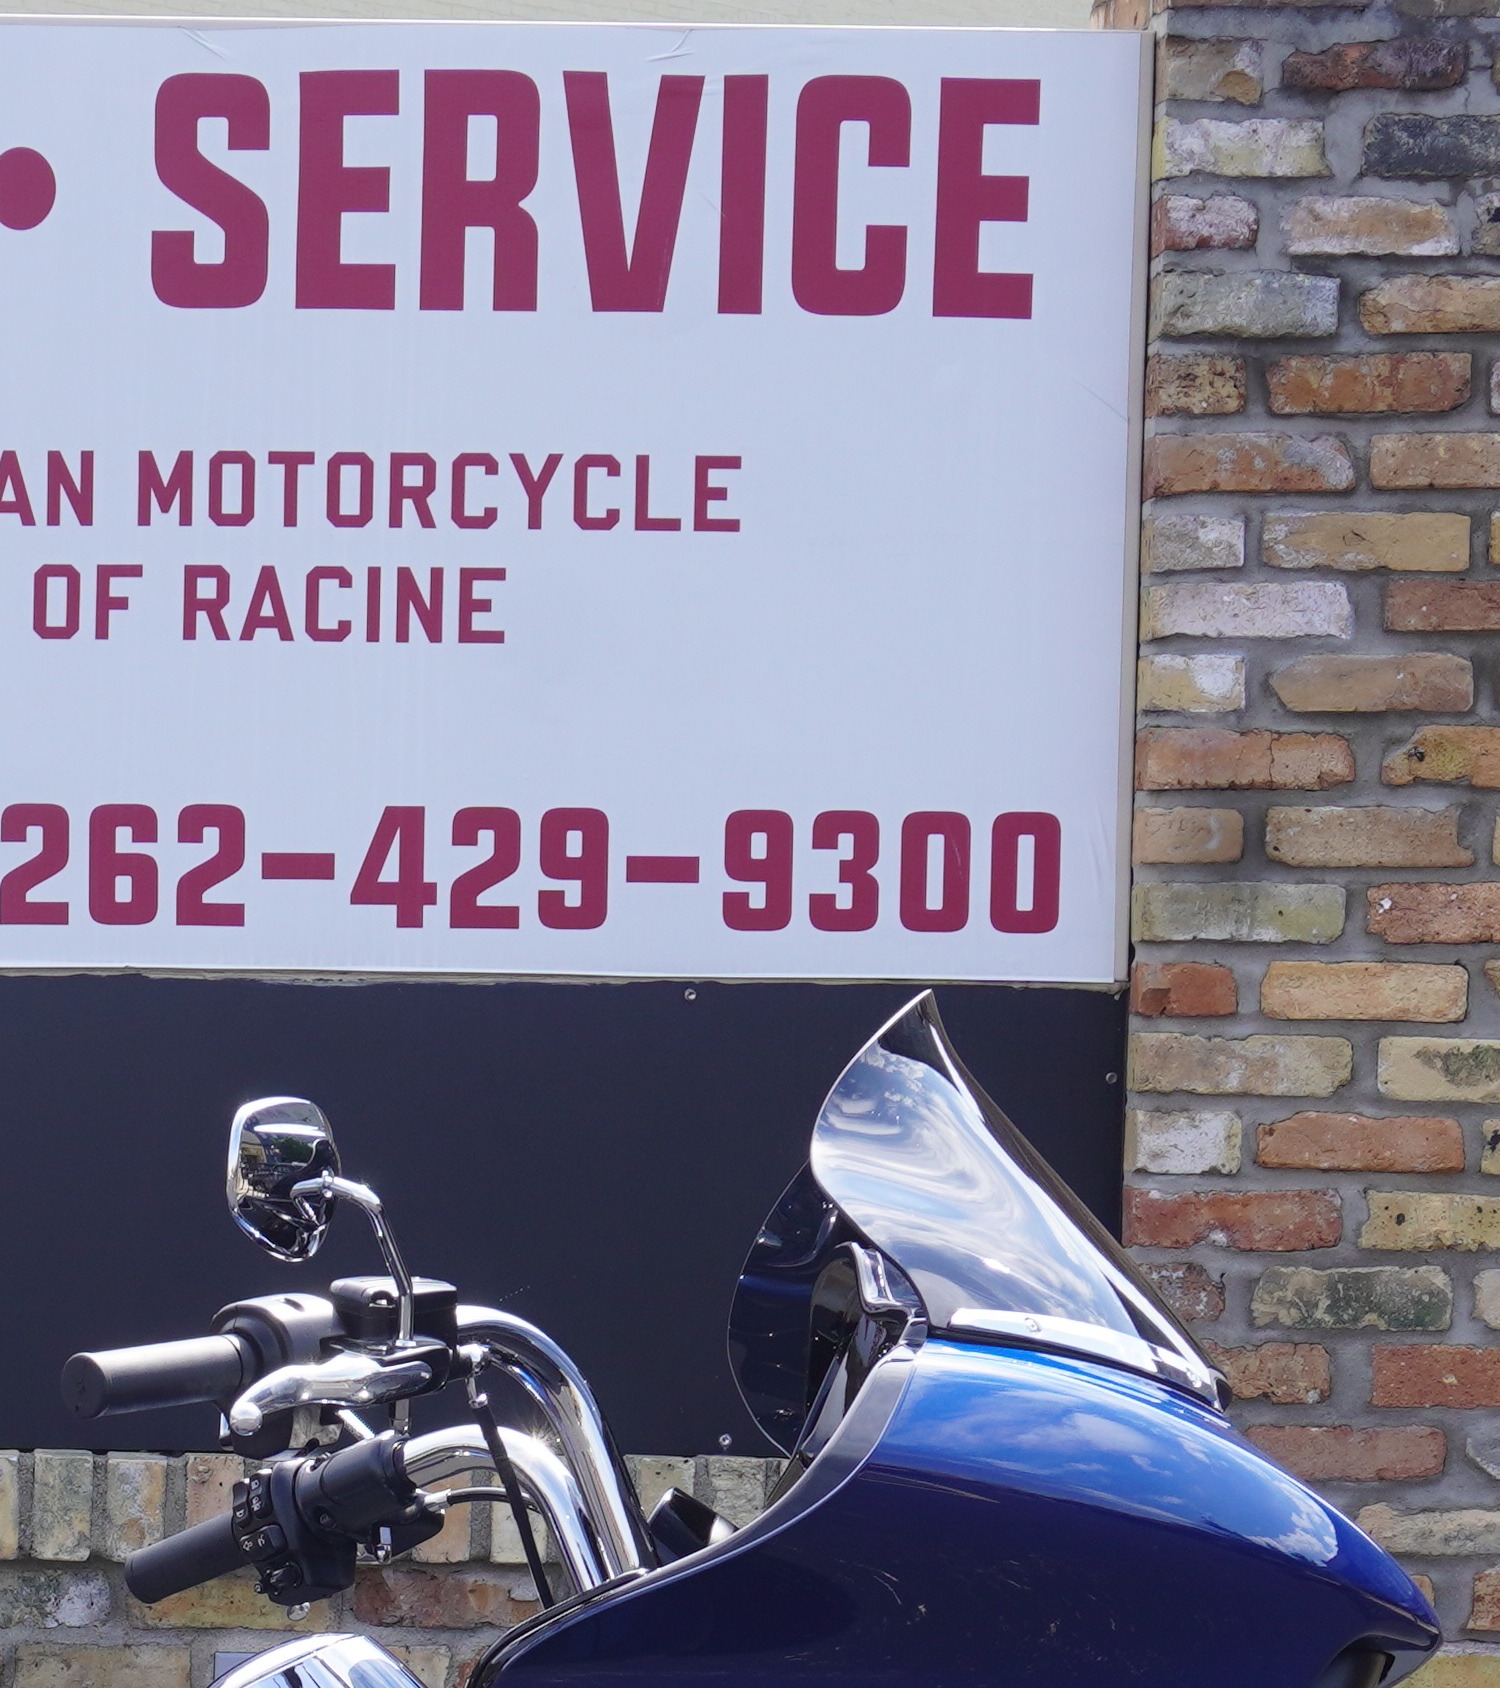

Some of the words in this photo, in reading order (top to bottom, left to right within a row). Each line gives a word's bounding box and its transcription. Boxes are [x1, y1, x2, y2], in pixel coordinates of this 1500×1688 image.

[151, 69, 1041, 320] SERVICE
[137, 450, 742, 533] MOTORCYCLE
[32, 564, 143, 640] OF
[183, 565, 506, 644] RACINE
[0, 803, 1062, 934] 262-429-9300
